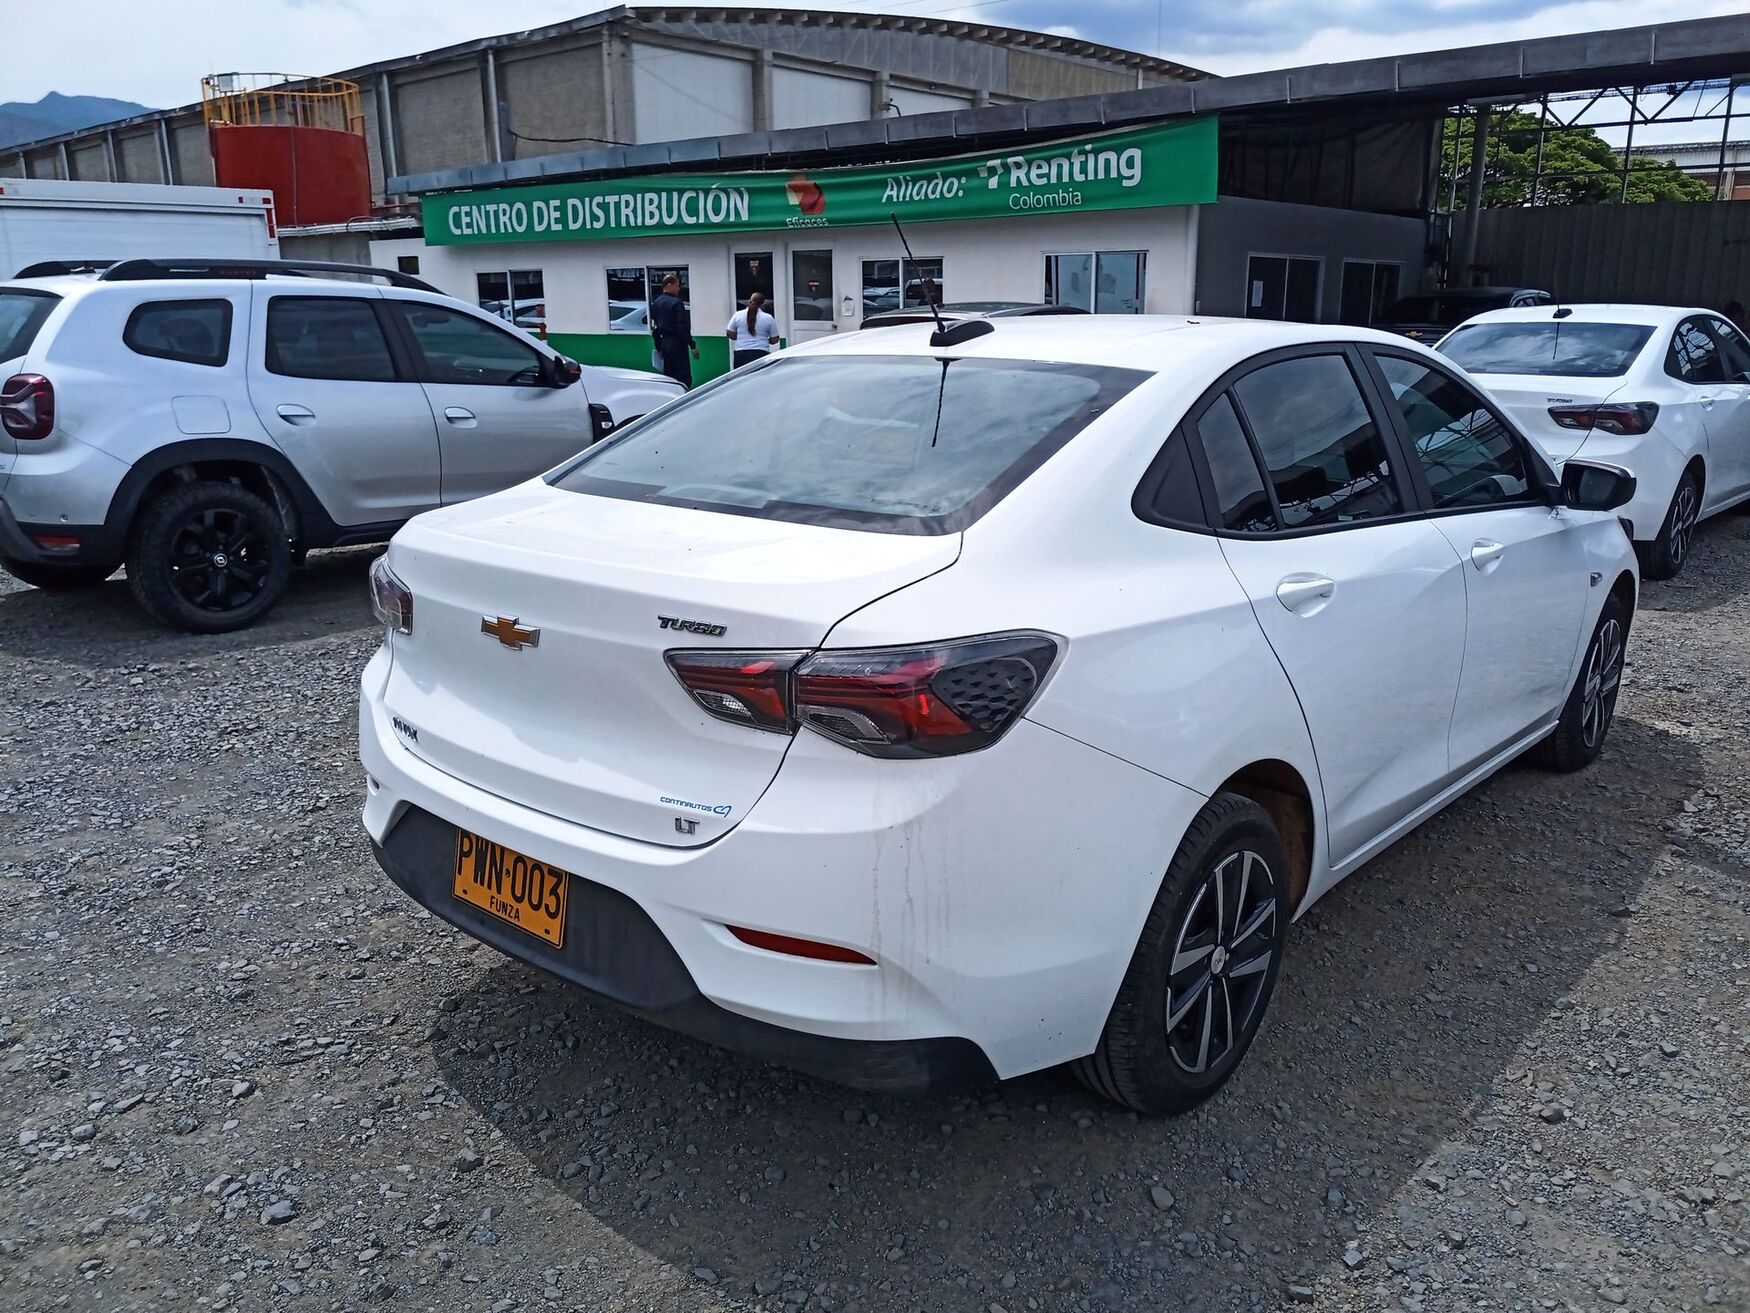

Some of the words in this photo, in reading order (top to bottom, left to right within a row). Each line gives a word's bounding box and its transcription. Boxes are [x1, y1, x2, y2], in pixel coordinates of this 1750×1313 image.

[1007, 144, 1142, 188] Renting
[881, 171, 967, 203] Aliado:
[1009, 188, 1082, 210] Colombia
[448, 202, 527, 235] CENTRO
[533, 199, 562, 232] DE
[567, 182, 749, 230] DISTRIBUCIÓN
[657, 613, 728, 637] TURBO
[674, 816, 700, 835] LT
[489, 895, 521, 922] FUNZA
